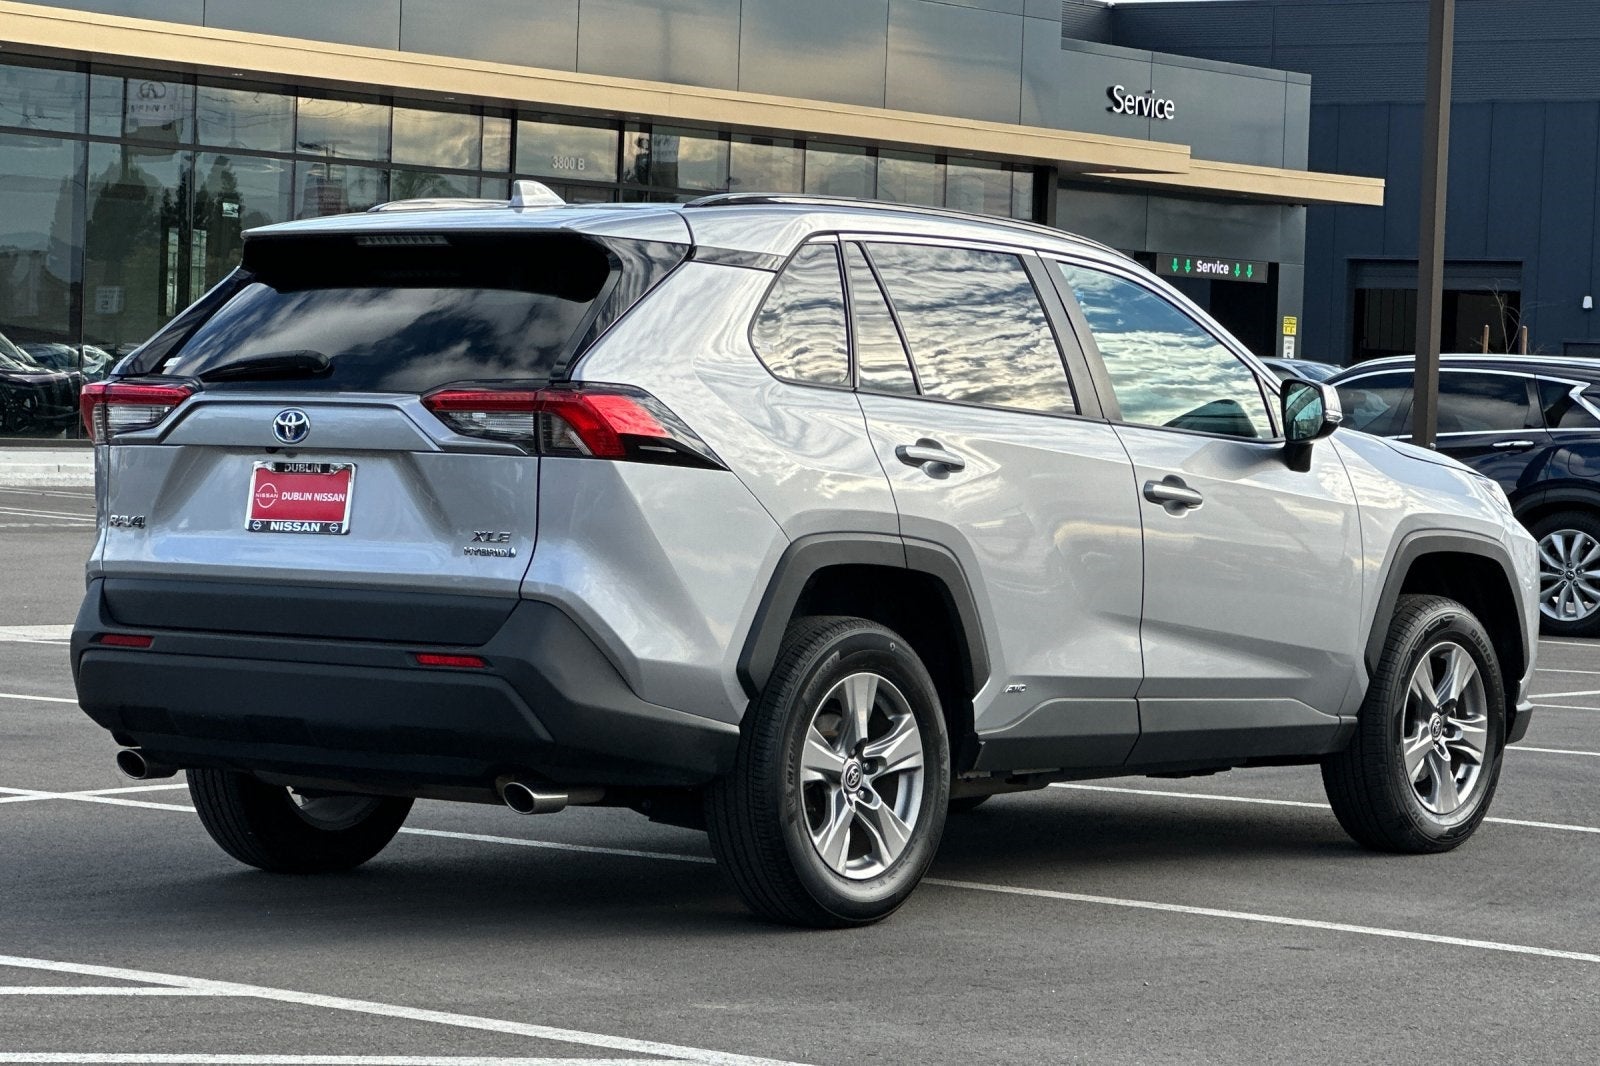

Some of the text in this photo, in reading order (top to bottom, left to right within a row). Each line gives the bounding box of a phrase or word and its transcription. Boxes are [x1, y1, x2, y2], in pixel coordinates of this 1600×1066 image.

[1112, 84, 1175, 120] Service
[552, 156, 585, 170] 3800 B
[1196, 260, 1229, 274] Service
[284, 463, 321, 473] DUBLIN
[281, 491, 345, 502] DUBLIN NISSAN
[270, 521, 320, 532] NISSAN
[471, 530, 511, 543] XLE
[463, 546, 509, 557] HYBRID
